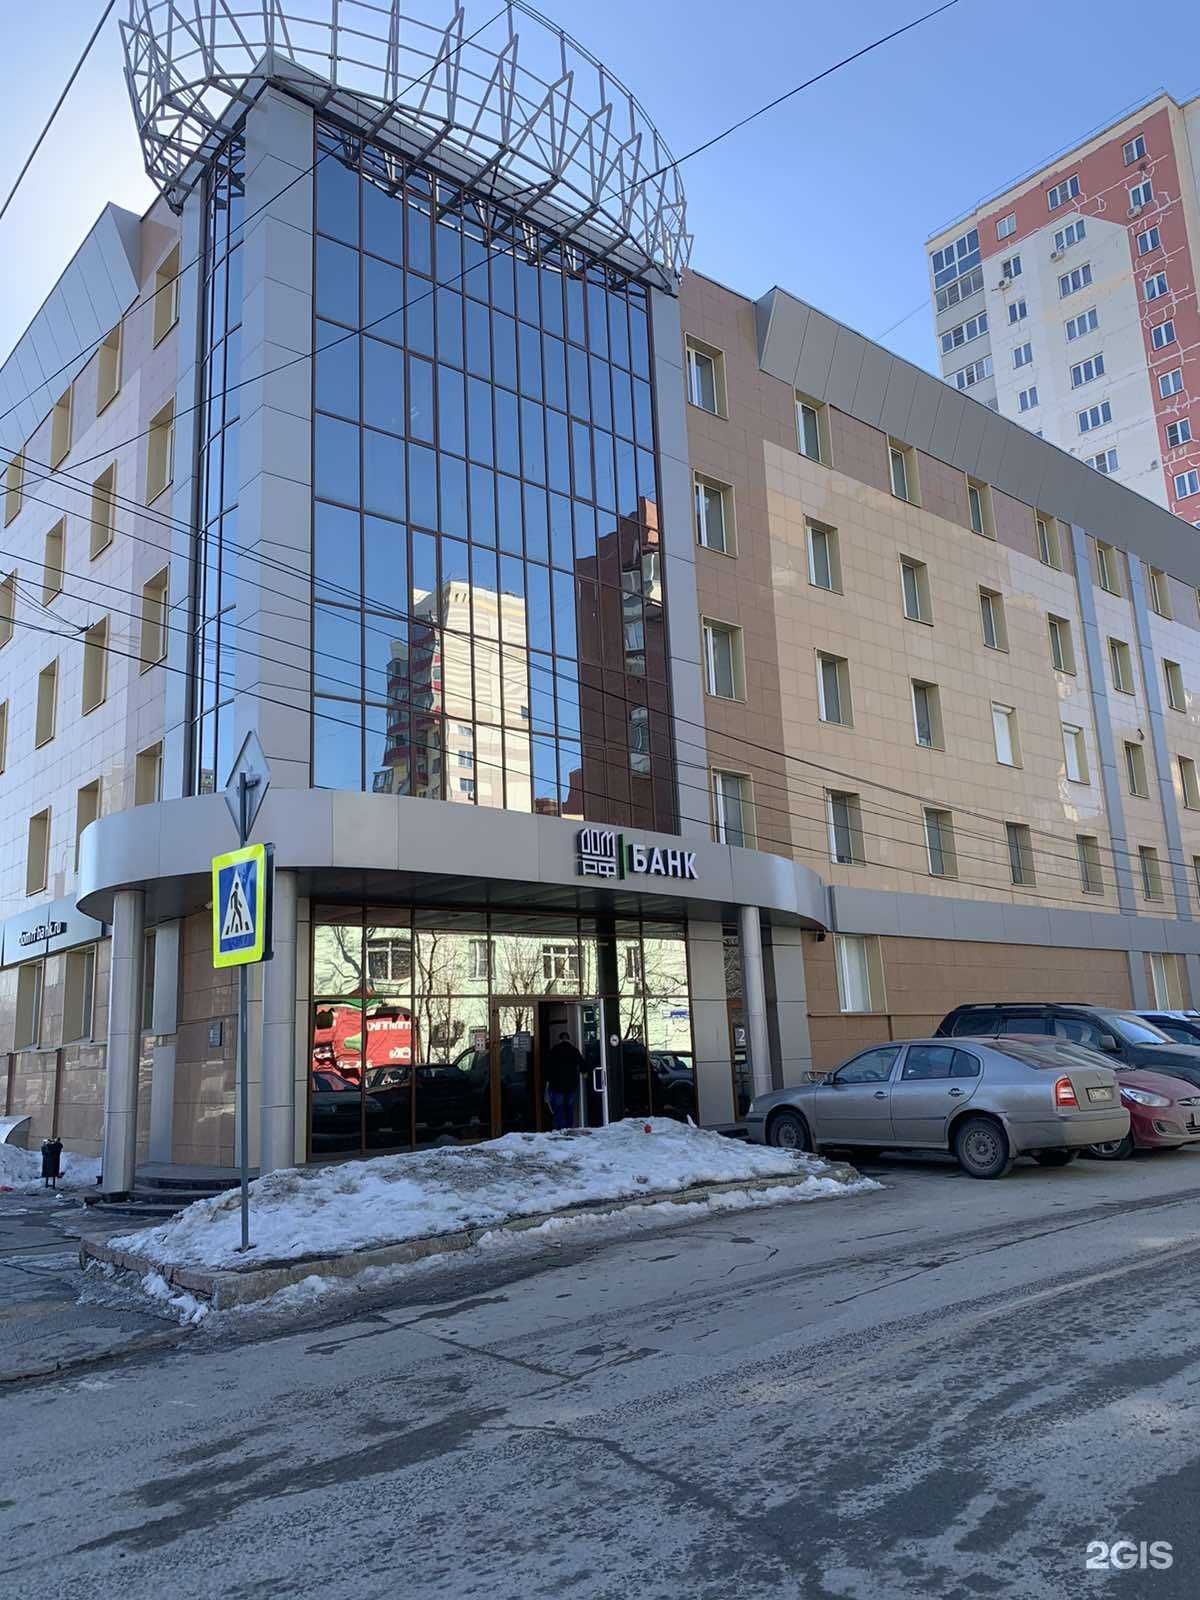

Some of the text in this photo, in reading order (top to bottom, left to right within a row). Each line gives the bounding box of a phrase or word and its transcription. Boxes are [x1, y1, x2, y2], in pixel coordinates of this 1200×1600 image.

[579, 828, 616, 857] ДОМ
[581, 860, 617, 878] РФ
[631, 842, 699, 880] БАНК
